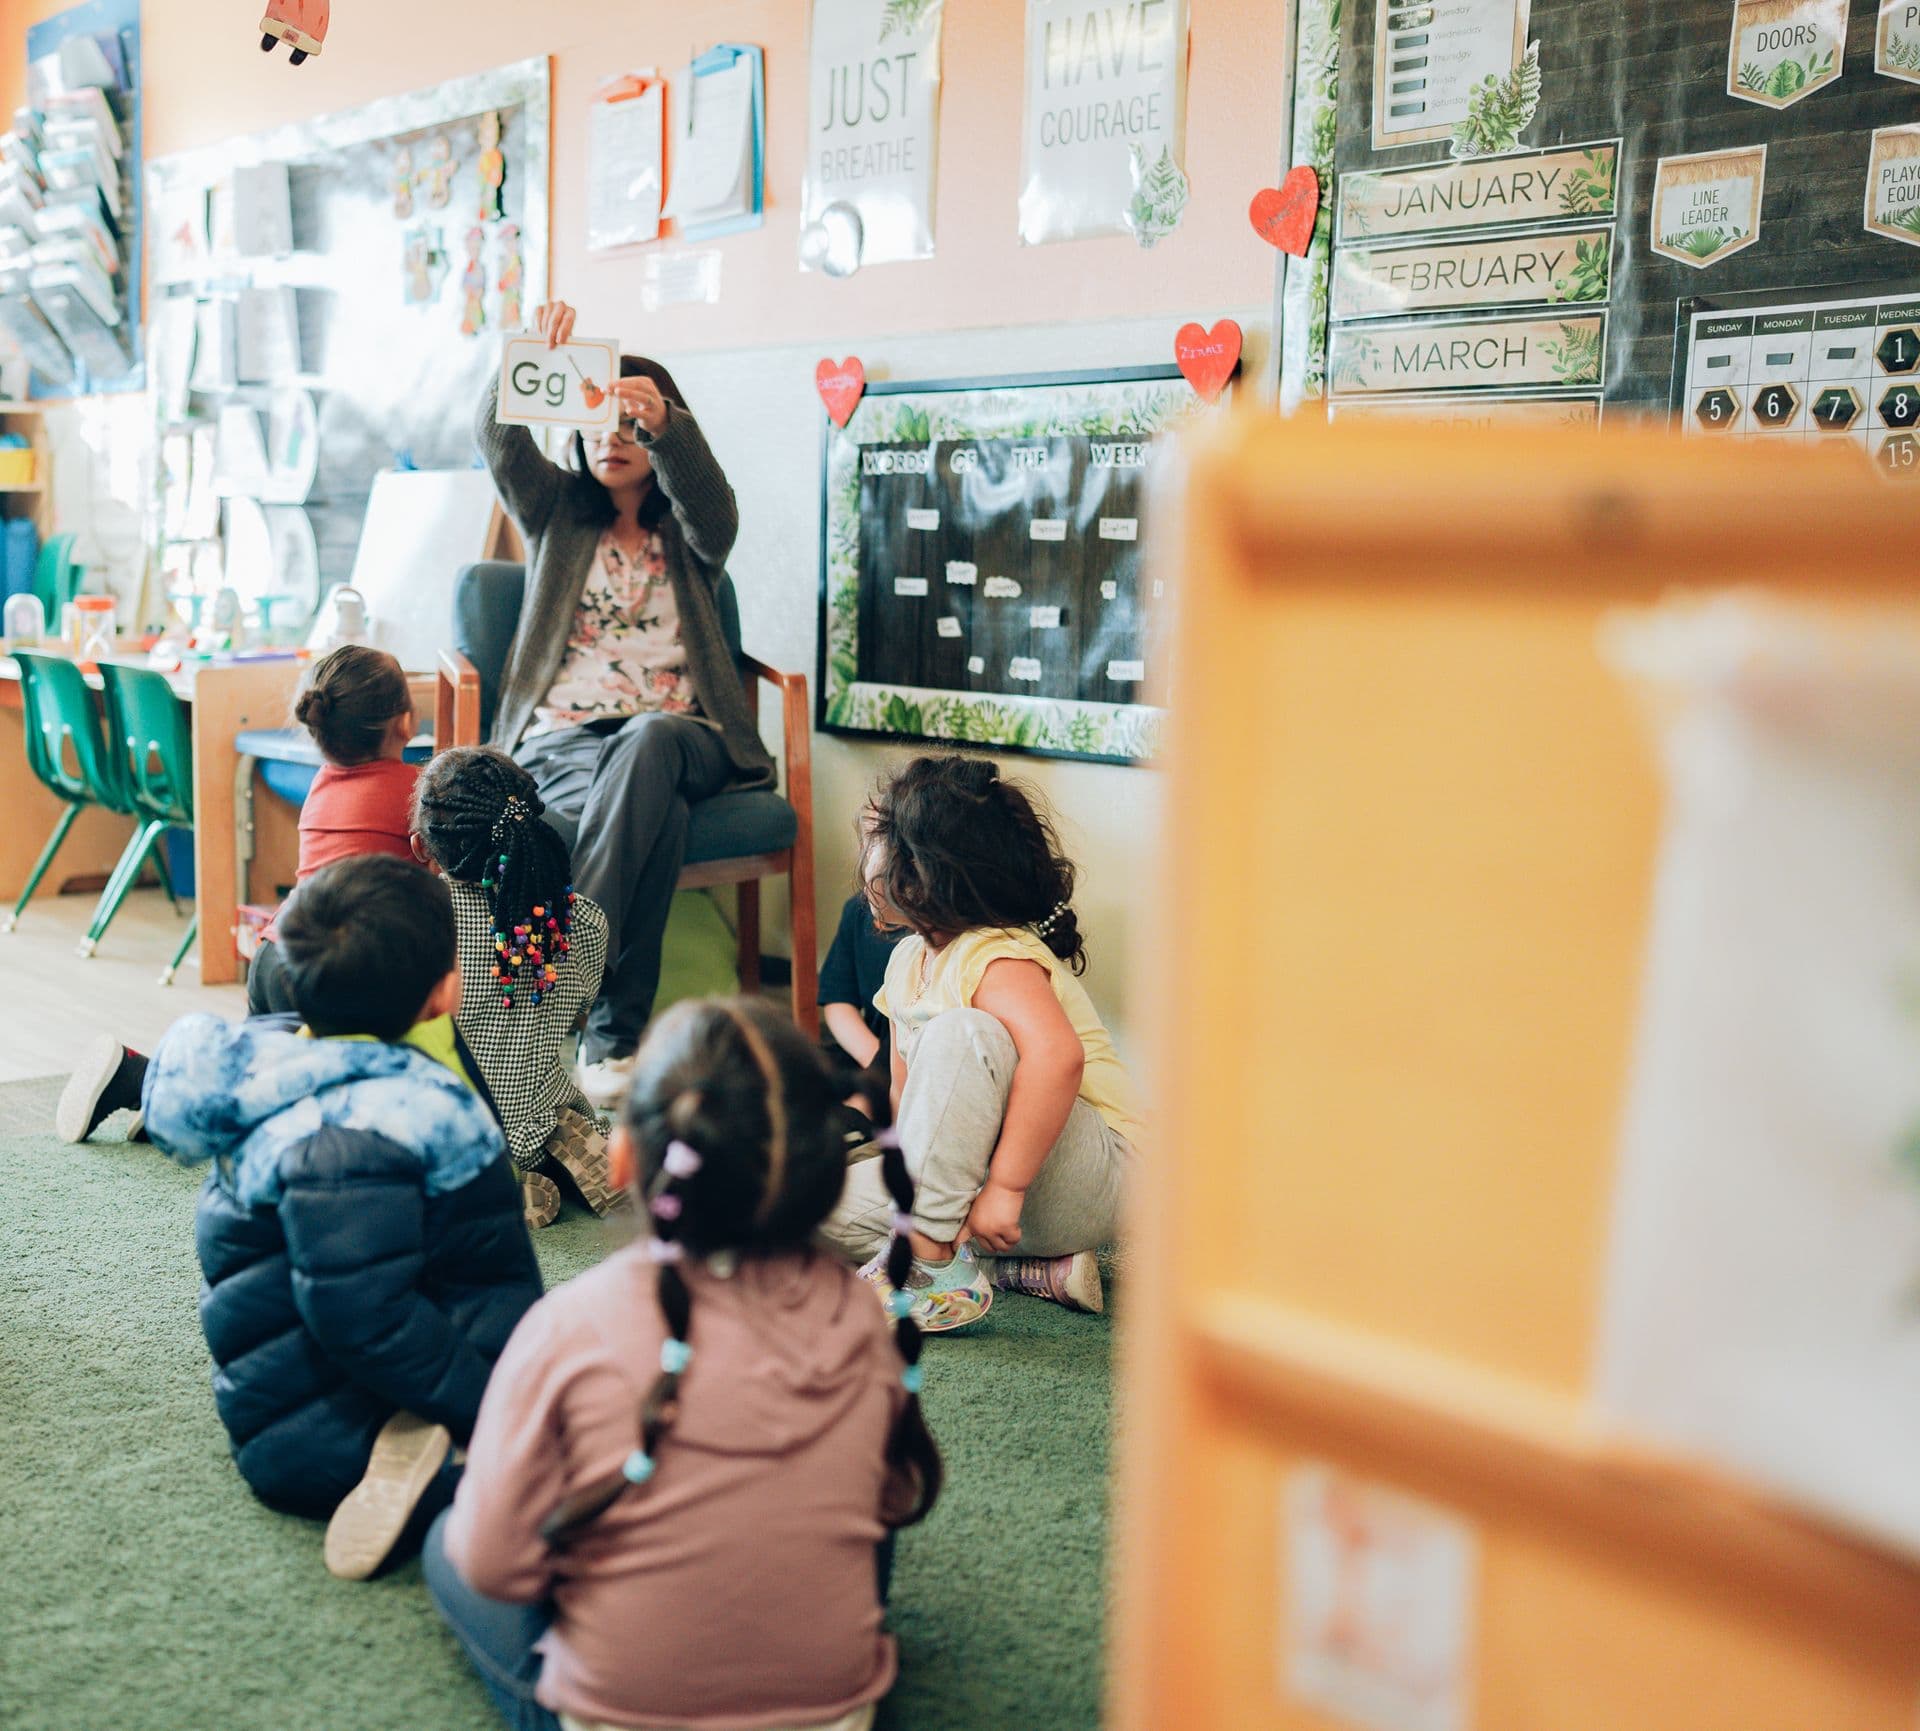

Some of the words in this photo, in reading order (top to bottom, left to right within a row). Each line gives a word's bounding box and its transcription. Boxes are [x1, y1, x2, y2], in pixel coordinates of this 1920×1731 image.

[1043, 0, 1164, 90] HAVE
[1757, 23, 1817, 52] DOORS
[823, 52, 917, 131] JUST
[1041, 92, 1160, 147] COURAGE
[820, 136, 915, 183] BREATHE
[1384, 167, 1561, 217] JANUARY
[1693, 189, 1719, 207] LINE
[1681, 207, 1729, 226] LEADER
[1707, 323, 1742, 334] SUNDAY
[1763, 318, 1804, 329] MONDAY
[1823, 313, 1867, 324] TUESDAY
[1393, 336, 1527, 374] MARCH
[1894, 337, 1905, 363] 1
[512, 361, 566, 407] Gg
[1709, 397, 1721, 421] 5
[1767, 393, 1779, 417] 6
[1829, 396, 1841, 421] 7
[1895, 393, 1908, 418] 8
[864, 451, 928, 473] WORDS
[1091, 444, 1144, 467] WEEK
[1887, 441, 1913, 468] 15
